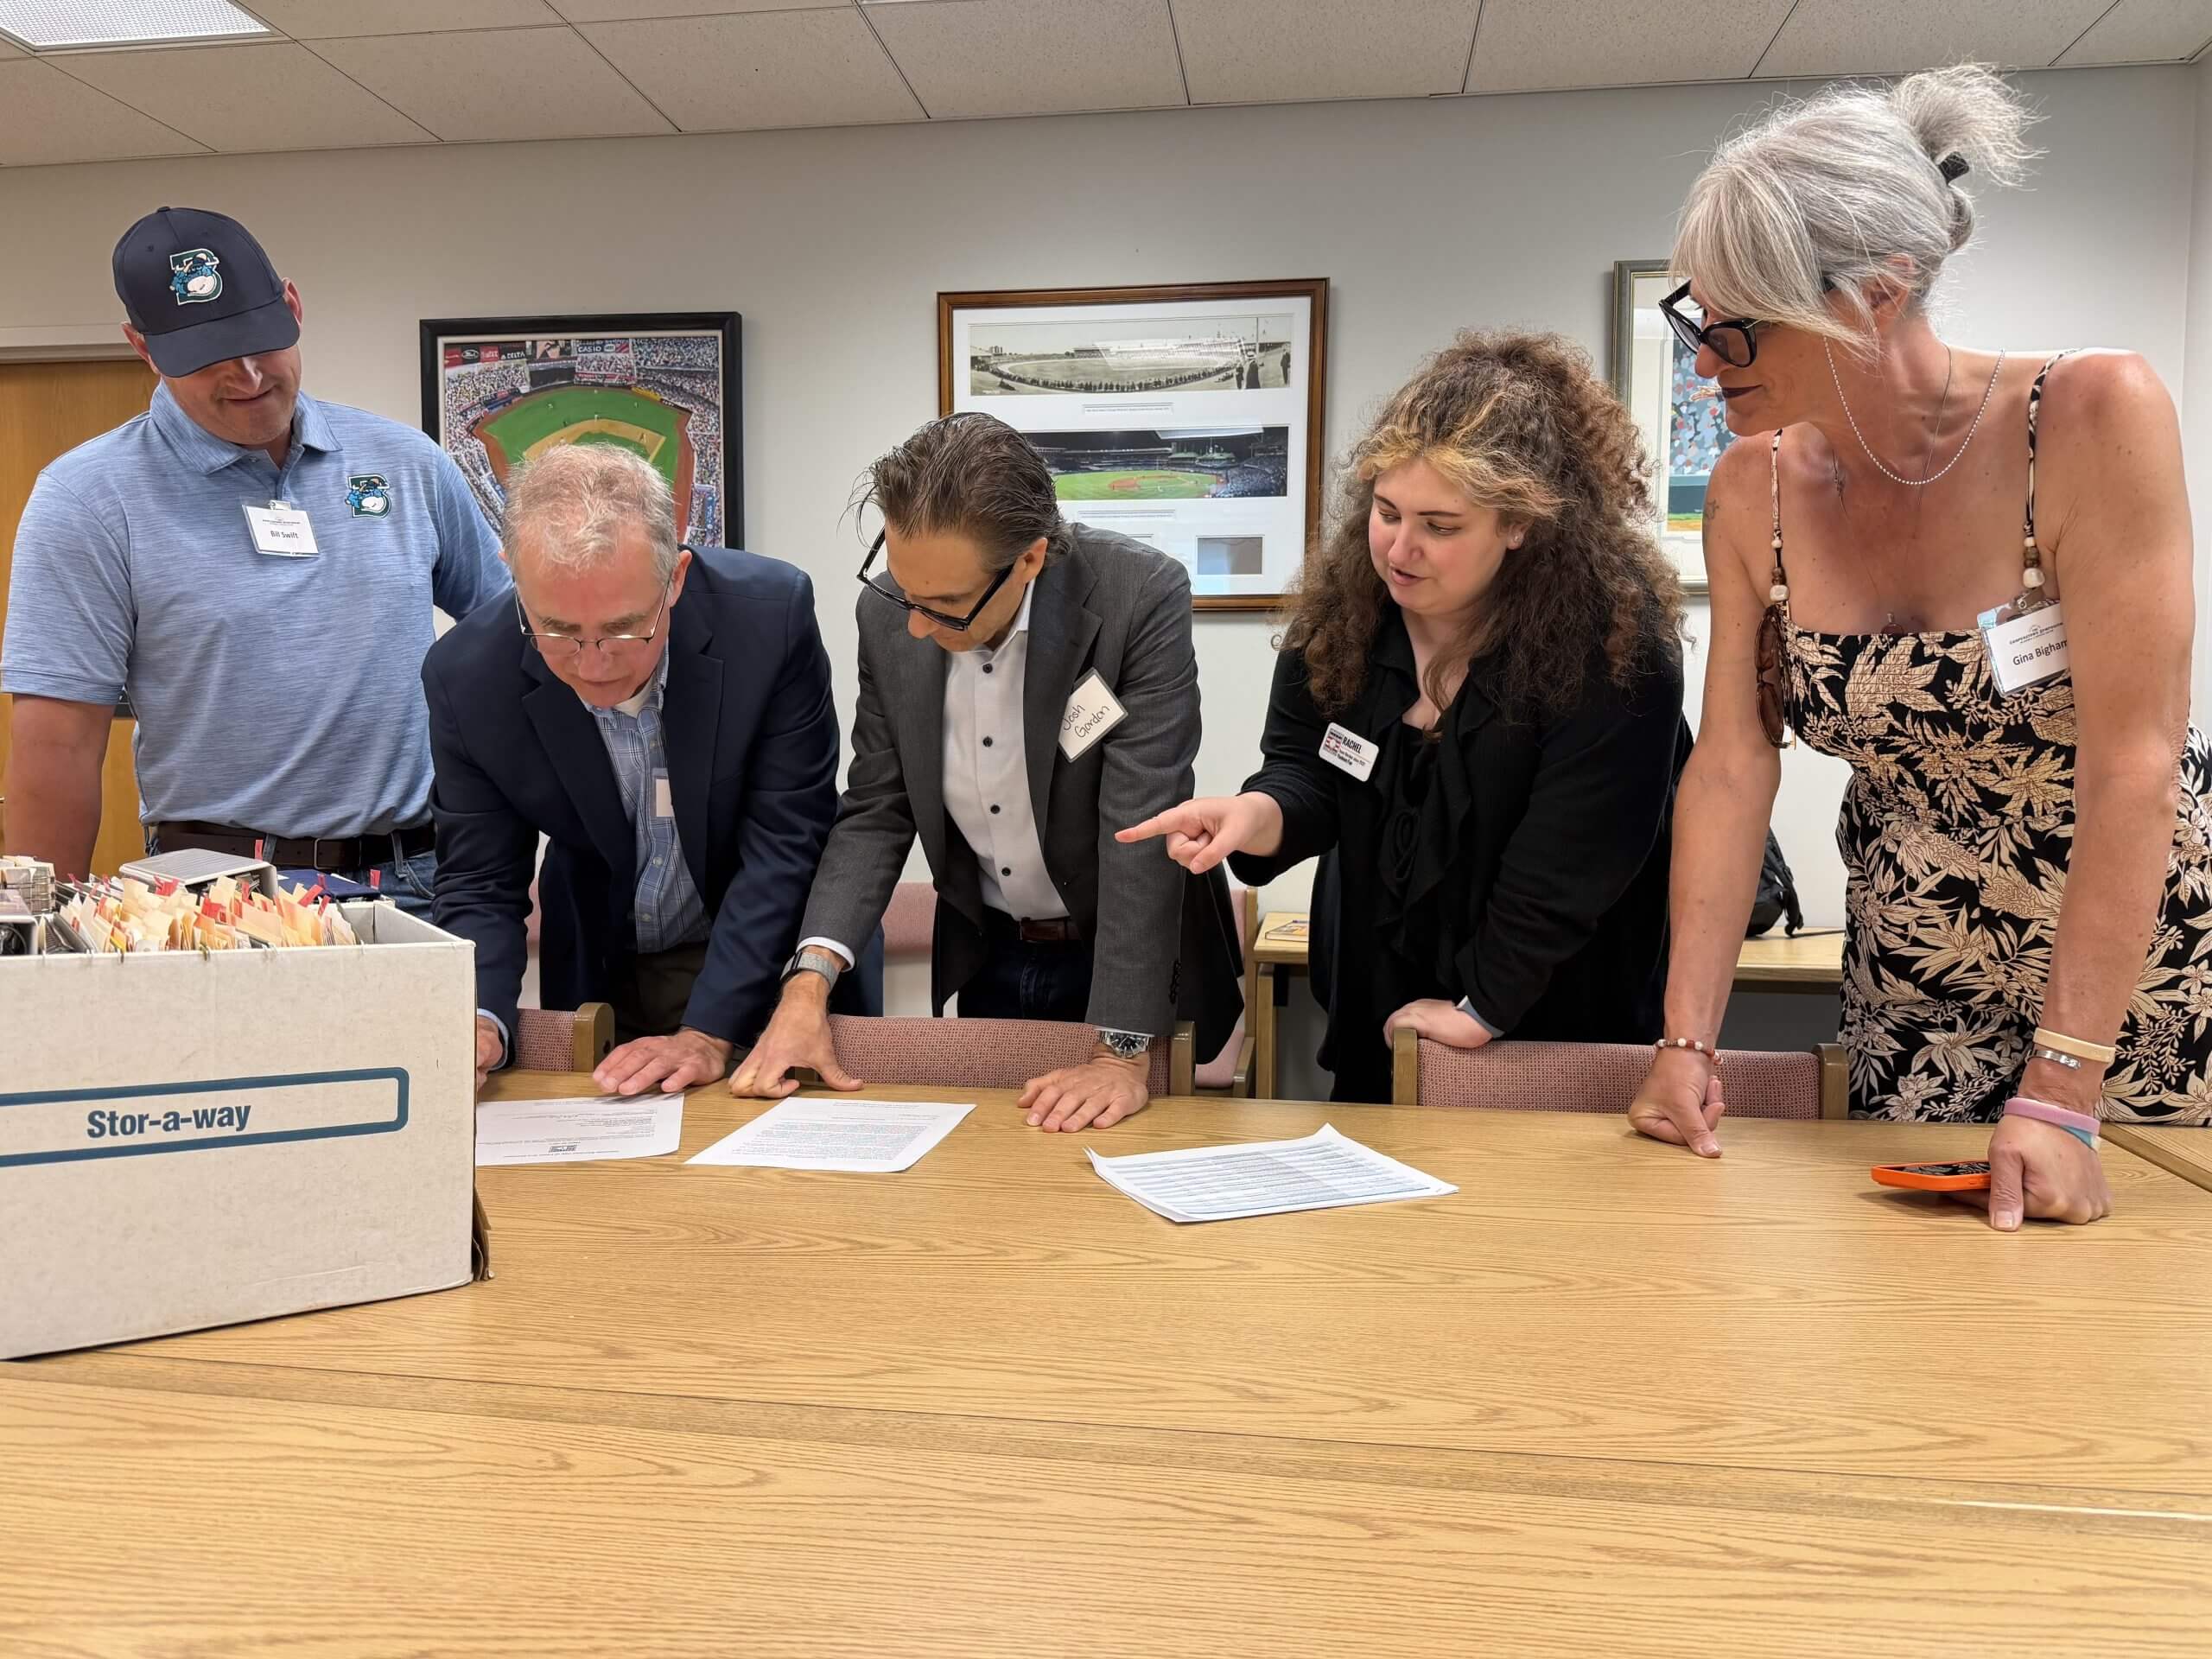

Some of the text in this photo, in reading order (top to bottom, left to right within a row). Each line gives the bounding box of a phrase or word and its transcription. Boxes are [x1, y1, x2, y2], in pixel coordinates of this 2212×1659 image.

[2012, 652, 2034, 665] Gina
[1062, 704, 1086, 731] Josh
[1074, 705, 1110, 738] Gordon
[1342, 736, 1363, 754] RACHEL
[86, 1105, 251, 1139] Stor-a-way
